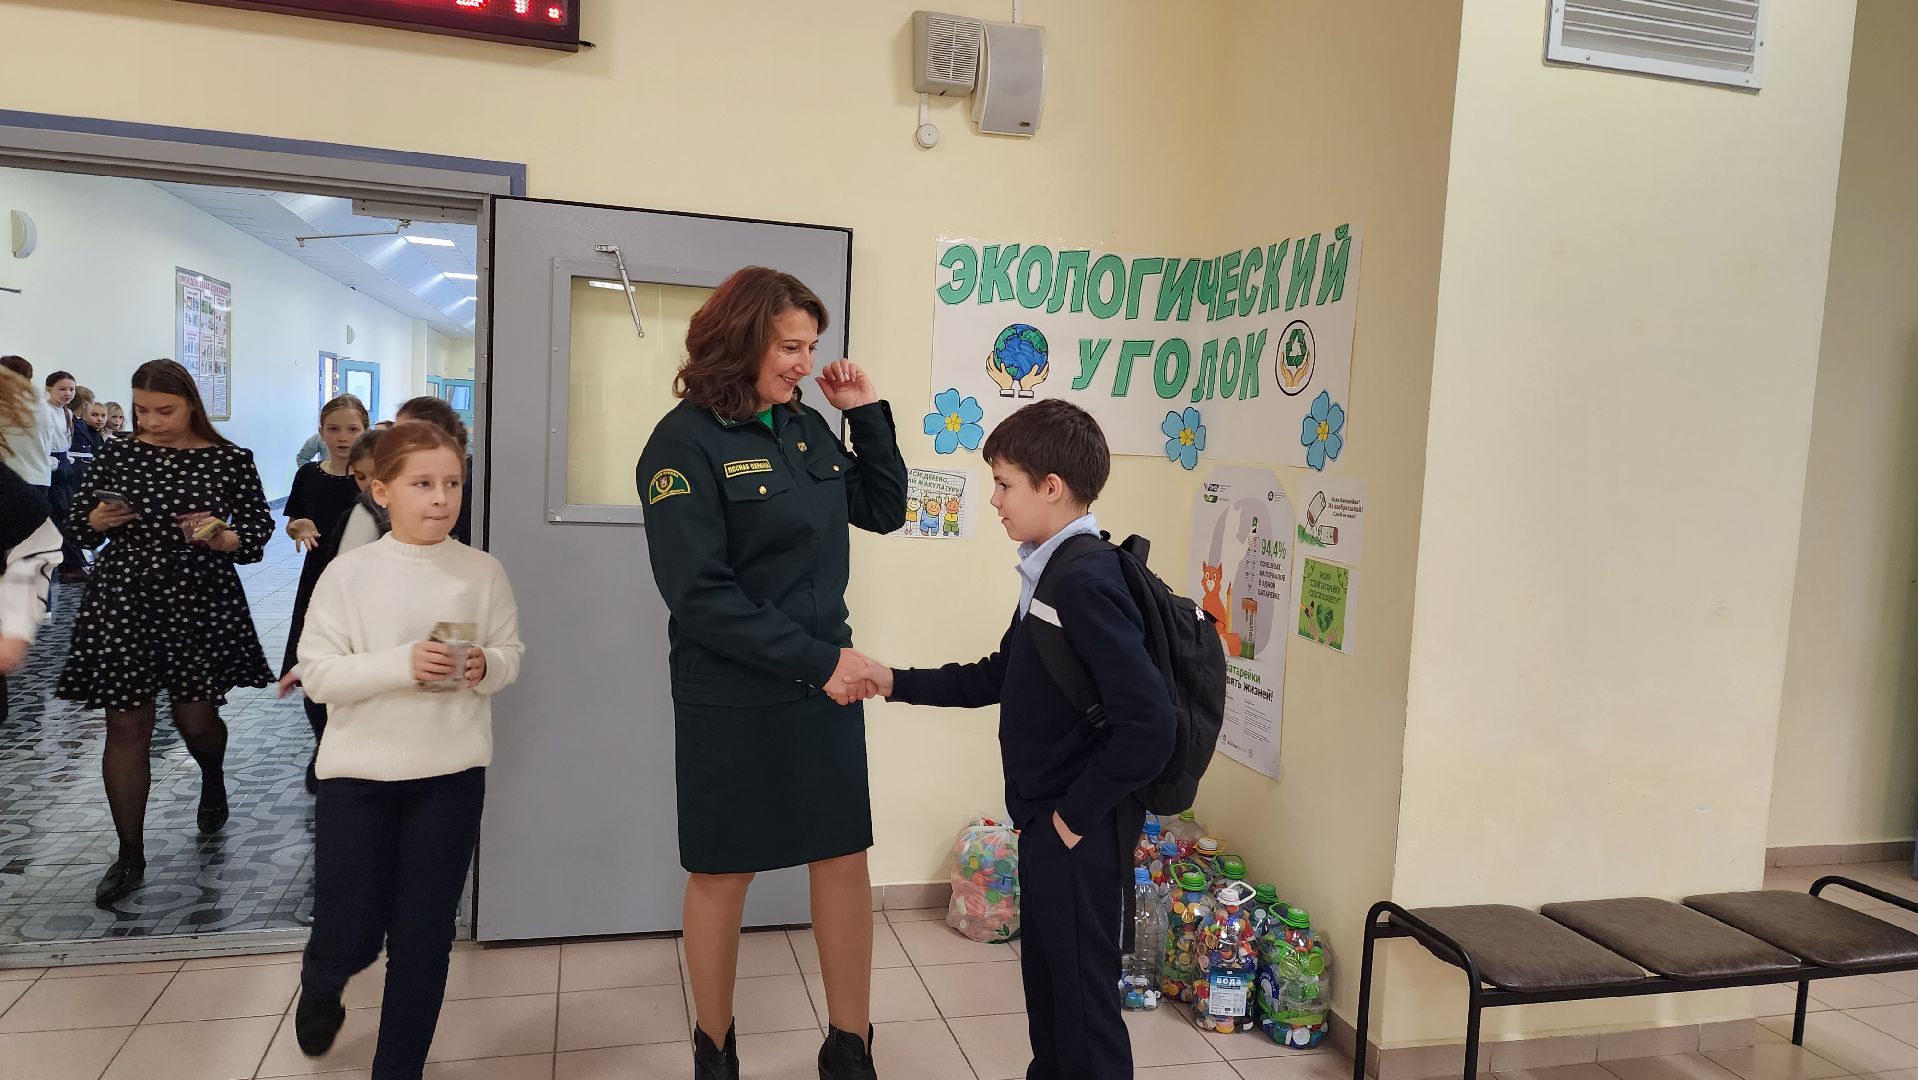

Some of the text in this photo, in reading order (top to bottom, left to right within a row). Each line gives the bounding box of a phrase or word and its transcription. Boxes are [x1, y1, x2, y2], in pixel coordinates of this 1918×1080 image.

[936, 223, 1353, 322] ЭКОЛОГИЧЕСКИЙ
[1072, 328, 1268, 403] УГОЛОК
[922, 473, 949, 484] ДЕРЕВО,
[1261, 538, 1287, 560] 94,4%
[1243, 682, 1274, 702] жизней!
